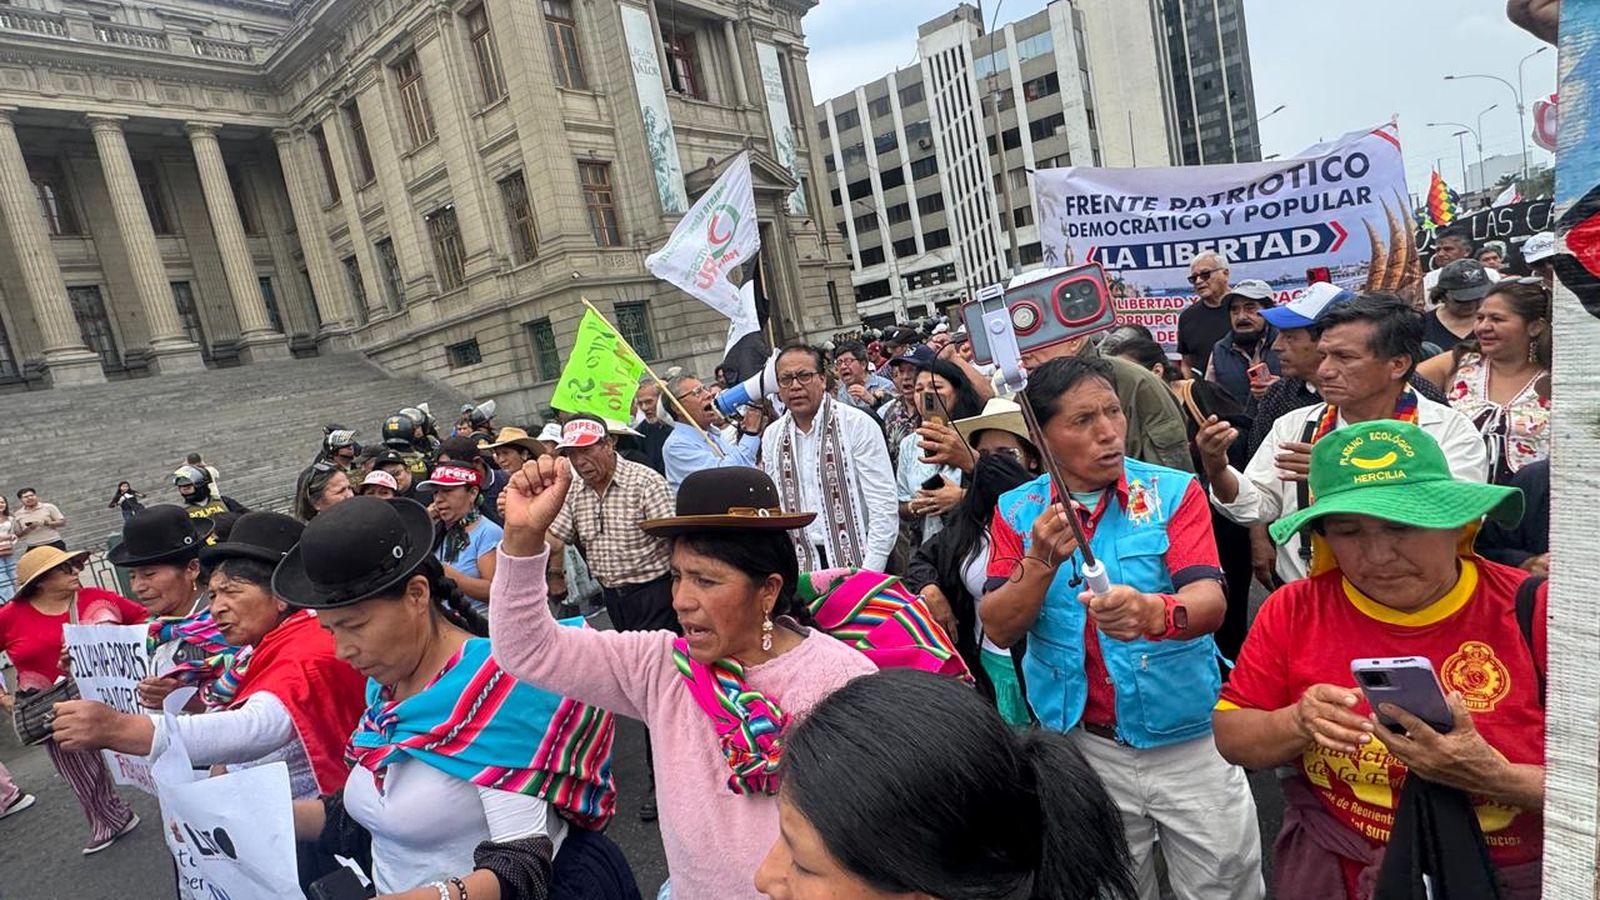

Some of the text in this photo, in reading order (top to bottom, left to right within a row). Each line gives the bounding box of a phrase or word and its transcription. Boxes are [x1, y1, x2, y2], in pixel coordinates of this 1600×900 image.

[1065, 194, 1159, 216] FRENTE
[1068, 186, 1372, 238] DEMOCRÁTICO Y POPULAR
[1472, 207, 1514, 241] LAS
[1101, 229, 1321, 269] LA LIBERTAD
[1117, 298, 1184, 309] LIBERTAD
[1354, 470, 1407, 484] HERCILIA
[1336, 797, 1349, 811] de
